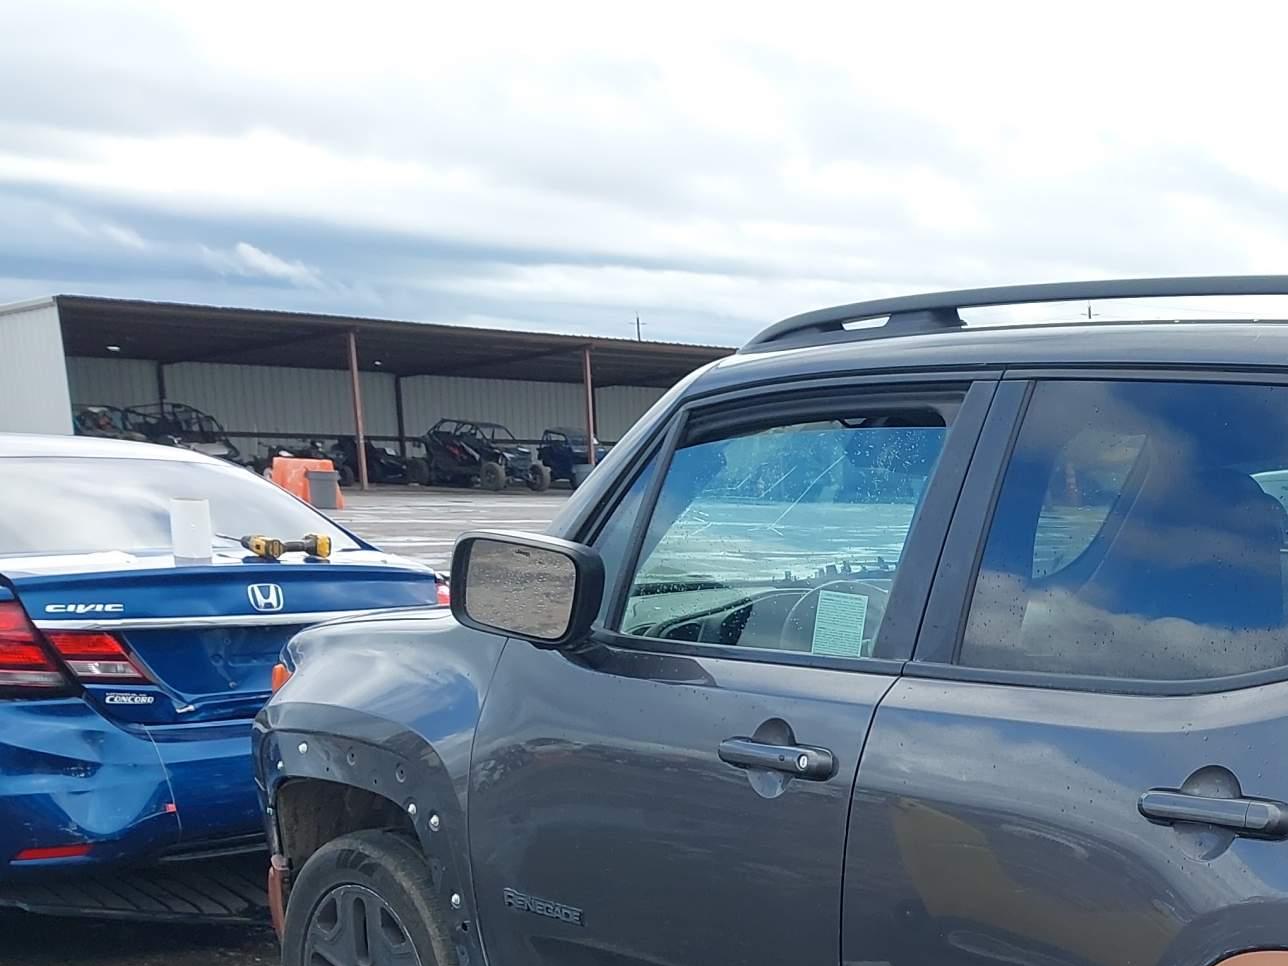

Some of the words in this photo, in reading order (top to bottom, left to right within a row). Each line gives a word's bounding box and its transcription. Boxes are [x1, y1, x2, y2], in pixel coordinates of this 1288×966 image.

[45, 603, 124, 613] CIVIC
[105, 695, 154, 704] CONCORD
[503, 887, 583, 926] RENEGADE
